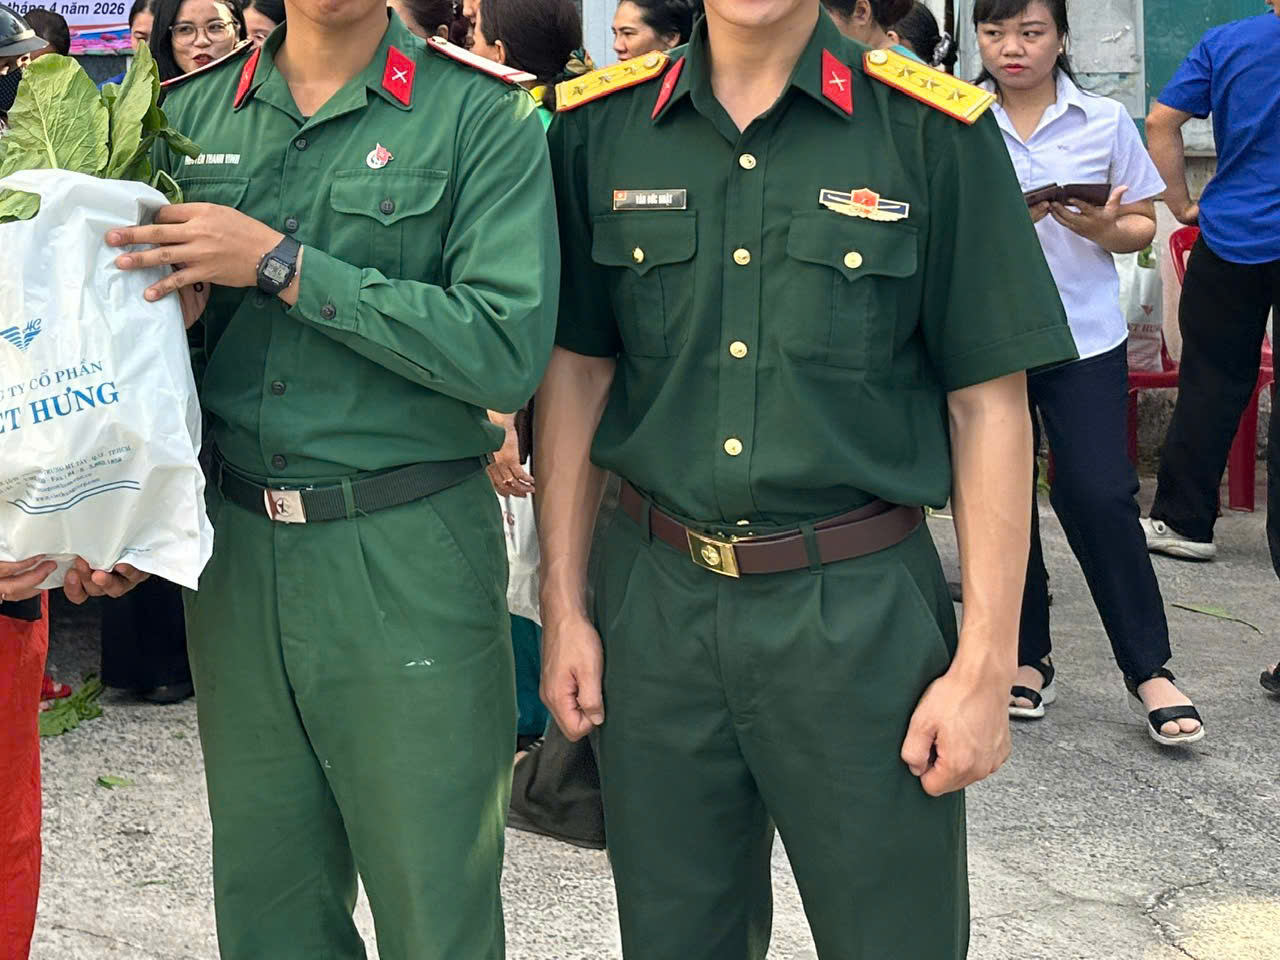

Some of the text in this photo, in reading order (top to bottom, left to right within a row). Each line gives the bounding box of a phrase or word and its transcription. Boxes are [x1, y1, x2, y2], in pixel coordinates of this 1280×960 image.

[49, 1, 58, 14] 4
[61, 2, 90, 15] năm
[93, 2, 126, 16] 2026
[7, 384, 26, 398] TY
[28, 381, 120, 425] HƯNG
